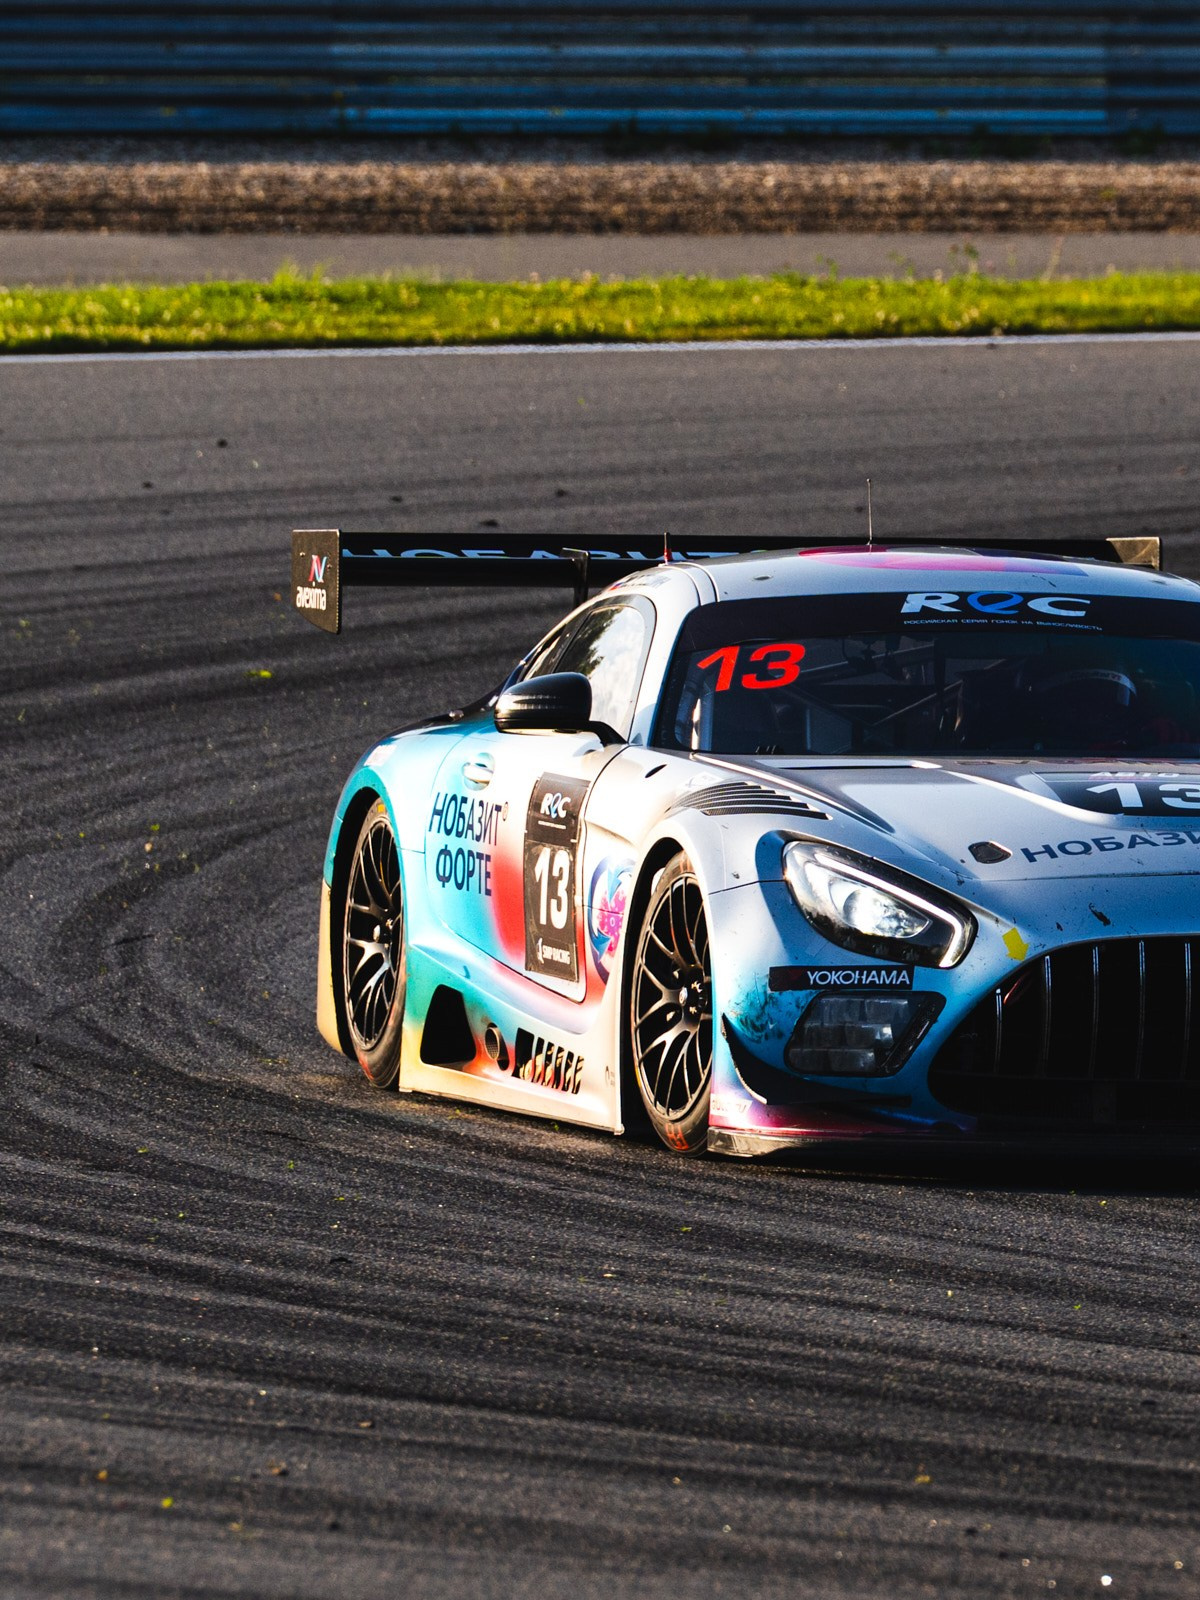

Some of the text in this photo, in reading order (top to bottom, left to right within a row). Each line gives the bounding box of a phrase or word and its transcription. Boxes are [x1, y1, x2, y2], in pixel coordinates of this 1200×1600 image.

[296, 581, 327, 611] avexima
[697, 643, 806, 692] 13
[436, 844, 492, 896] ФОРТЕ
[535, 847, 570, 929] 13
[807, 970, 910, 985] YOKOHAMA
